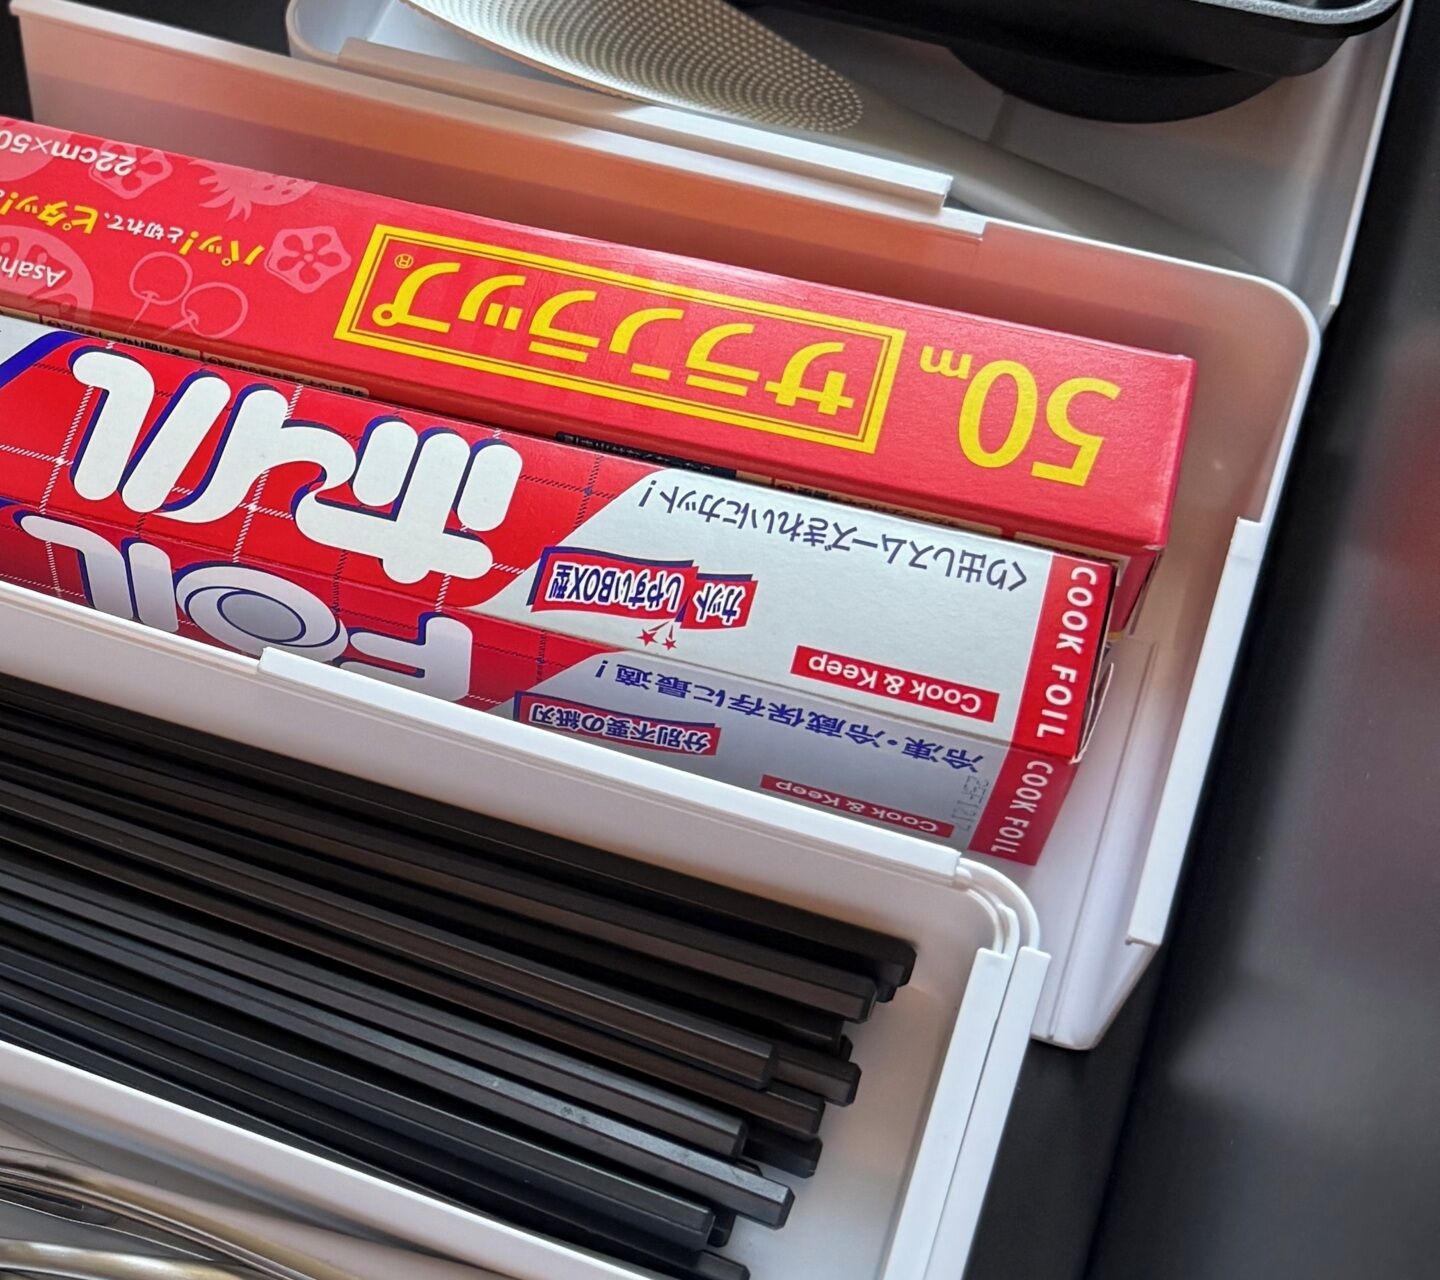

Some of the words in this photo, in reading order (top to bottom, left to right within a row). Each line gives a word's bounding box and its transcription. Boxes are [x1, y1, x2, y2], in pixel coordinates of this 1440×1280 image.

[70, 346, 523, 584] ホイル
[547, 561, 683, 615] しやすいBOX型
[693, 581, 747, 624] カット
[1053, 565, 1098, 655] COOK
[808, 655, 878, 689] Keep
[884, 673, 906, 694] &
[911, 681, 982, 715] Cook
[1036, 664, 1077, 739] FOIL
[529, 701, 710, 753] 分別不要の紙刃
[775, 779, 841, 807] Keep
[847, 799, 865, 814] &
[1008, 761, 1055, 815] COOK
[871, 808, 938, 833] Cook
[990, 816, 1030, 854] FOIL
